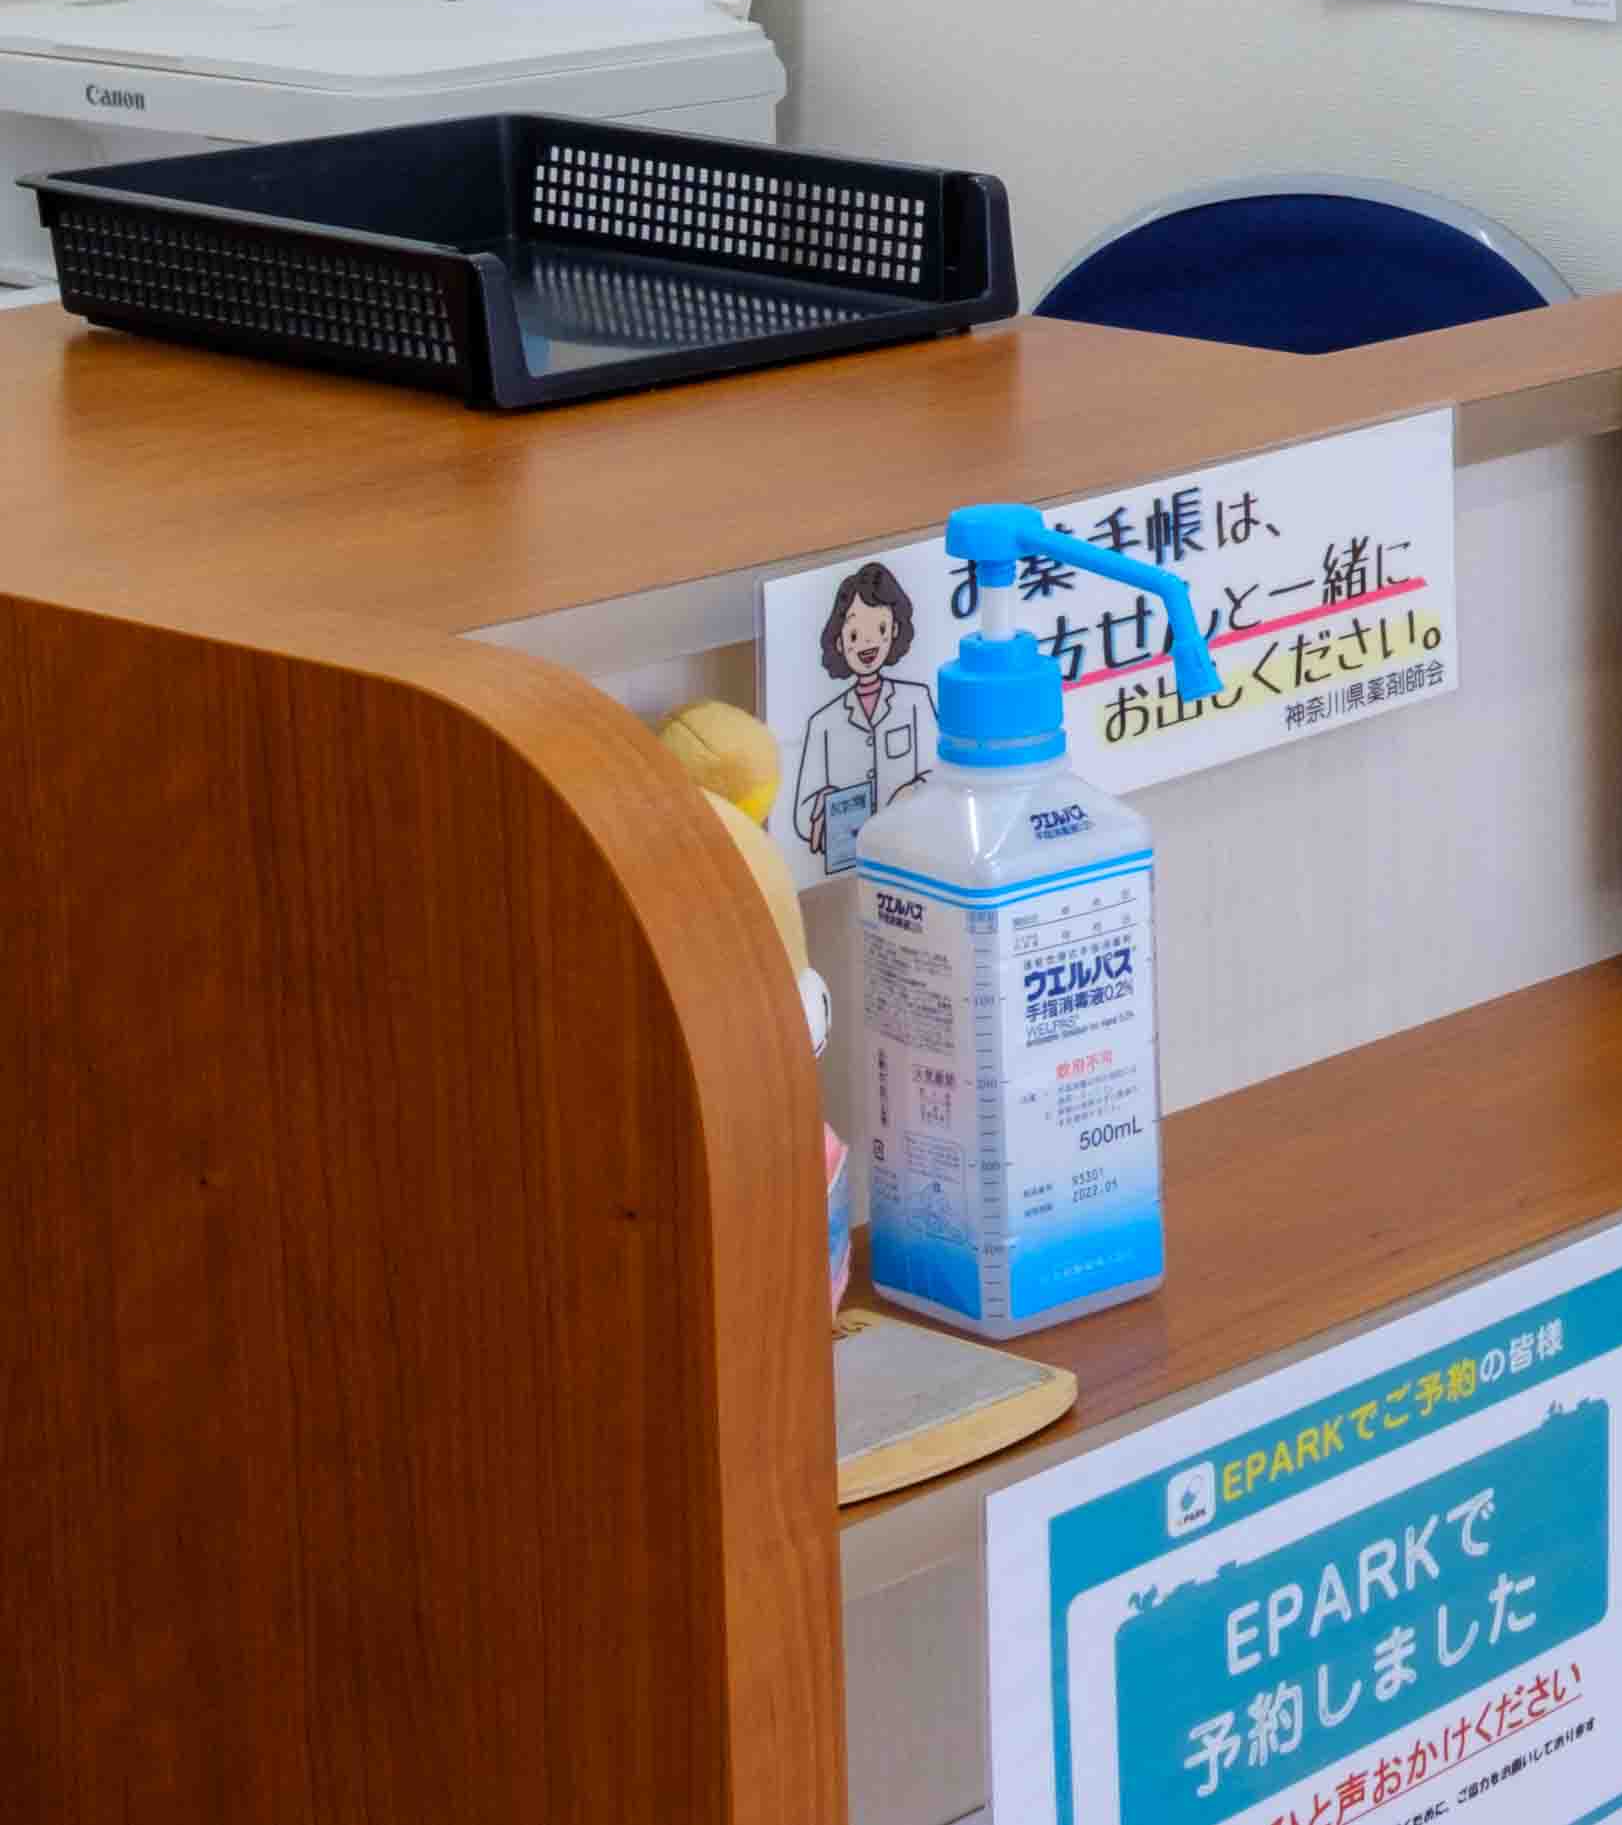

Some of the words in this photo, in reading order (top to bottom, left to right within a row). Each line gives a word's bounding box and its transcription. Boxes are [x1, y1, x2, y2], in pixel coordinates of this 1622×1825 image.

[85, 84, 147, 113] Canon
[1284, 660, 1447, 733] 神奈川県薬剤師会
[1024, 946, 1134, 1002] ウエルパス
[1079, 1115, 1143, 1152] 500mL
[1221, 1318, 1564, 1502] EPARKでご予約の皆様
[1227, 1487, 1495, 1678] EPARKで
[1184, 1571, 1537, 1798] 予約しました
